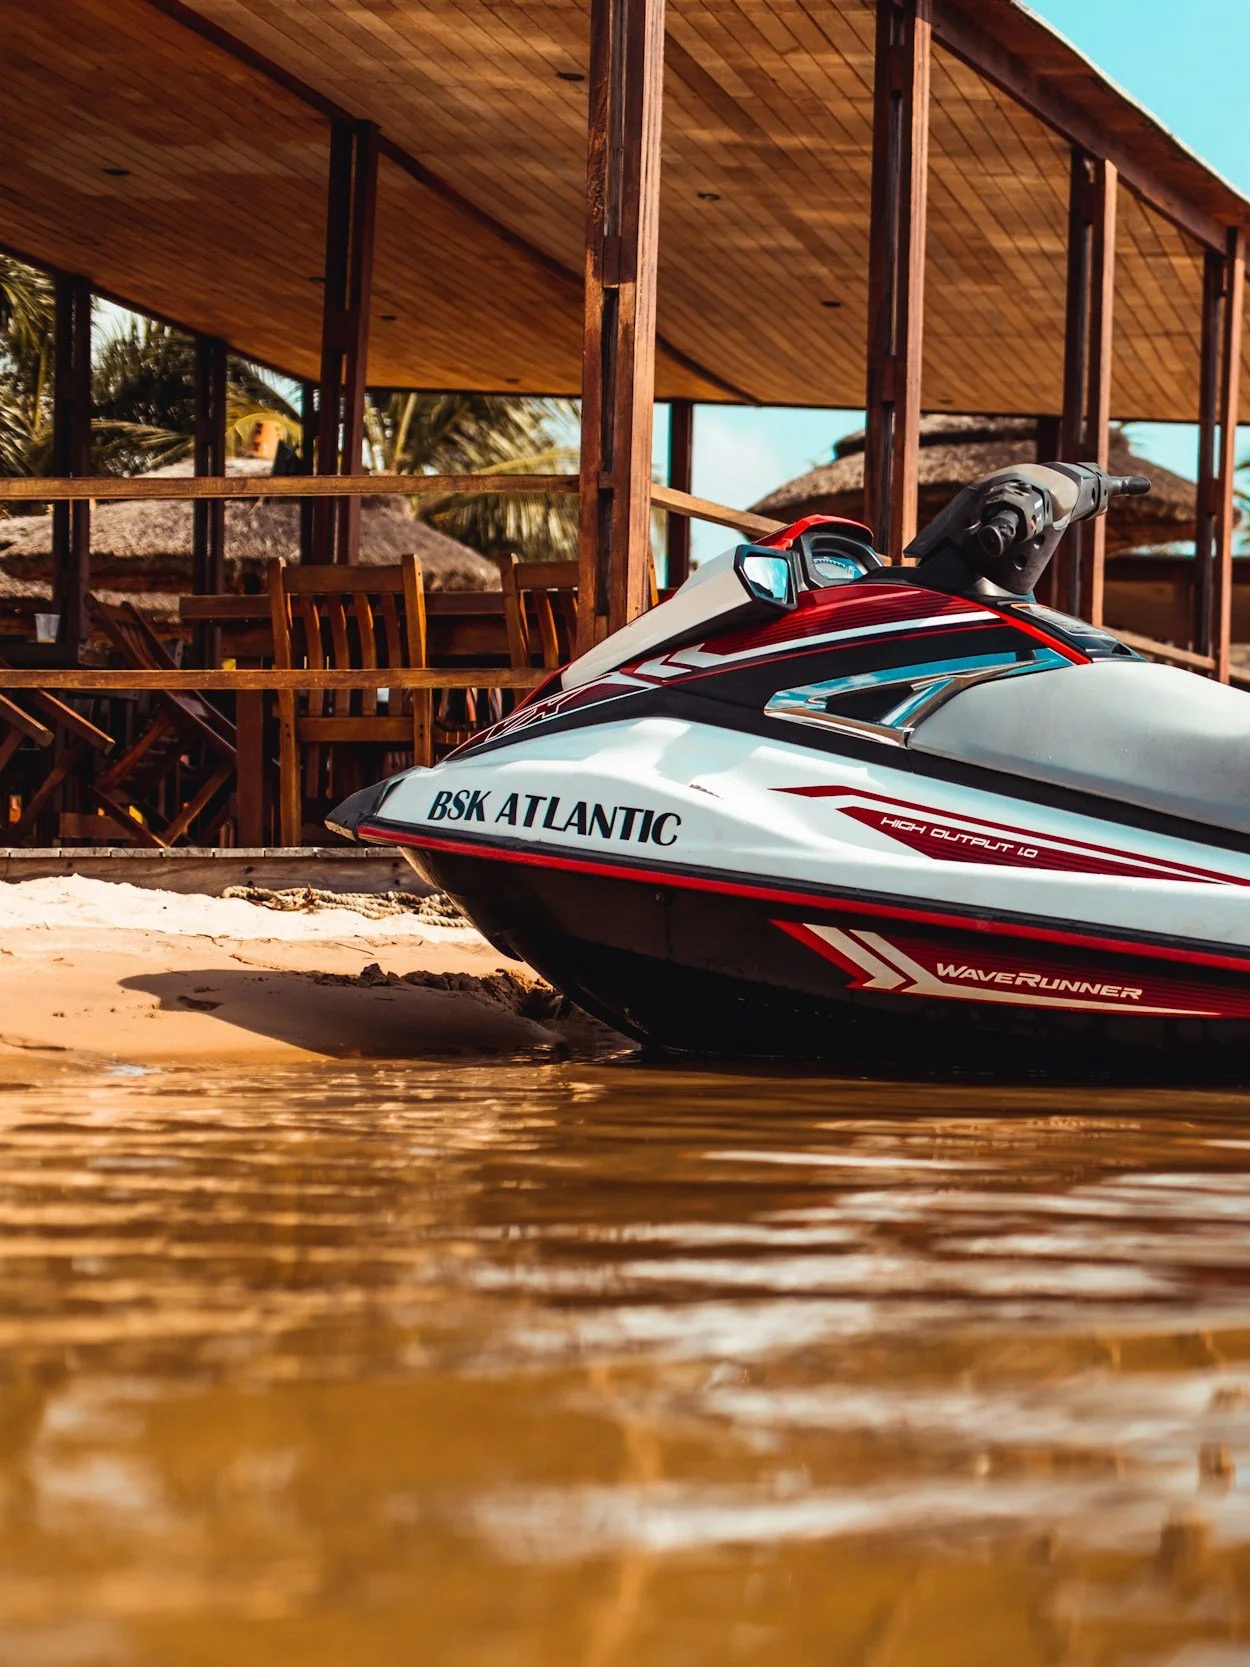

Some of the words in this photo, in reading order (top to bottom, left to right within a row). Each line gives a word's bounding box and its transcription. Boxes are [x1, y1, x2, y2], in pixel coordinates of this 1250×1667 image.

[427, 789, 492, 822] BSK
[495, 792, 682, 846] ATLANTIC
[880, 817, 927, 834] HIGH
[930, 828, 1015, 853] OUTPUT
